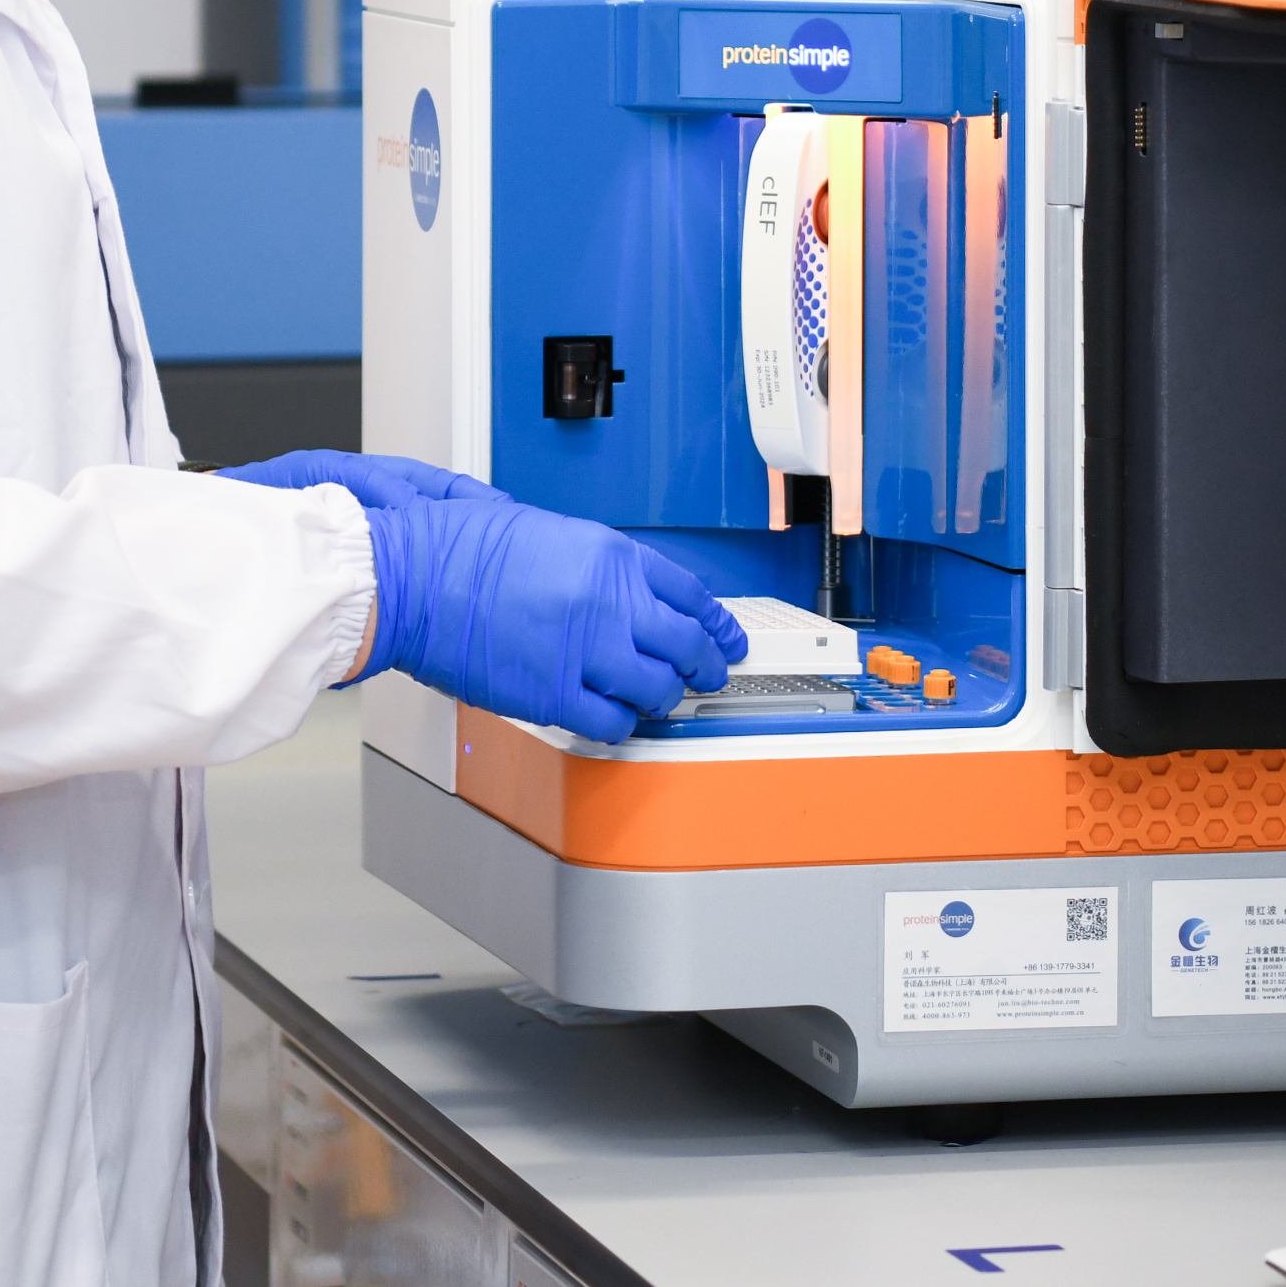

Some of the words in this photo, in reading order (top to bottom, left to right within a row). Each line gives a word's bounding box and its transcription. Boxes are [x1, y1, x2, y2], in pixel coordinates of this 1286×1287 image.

[722, 44, 850, 72] proteinsimple
[377, 134, 440, 186] proteinsimple
[759, 176, 778, 236] cIEF
[903, 913, 973, 927] proteinsimple
[1024, 963, 1038, 971] +86
[1040, 962, 1095, 971] 139-1779-3341
